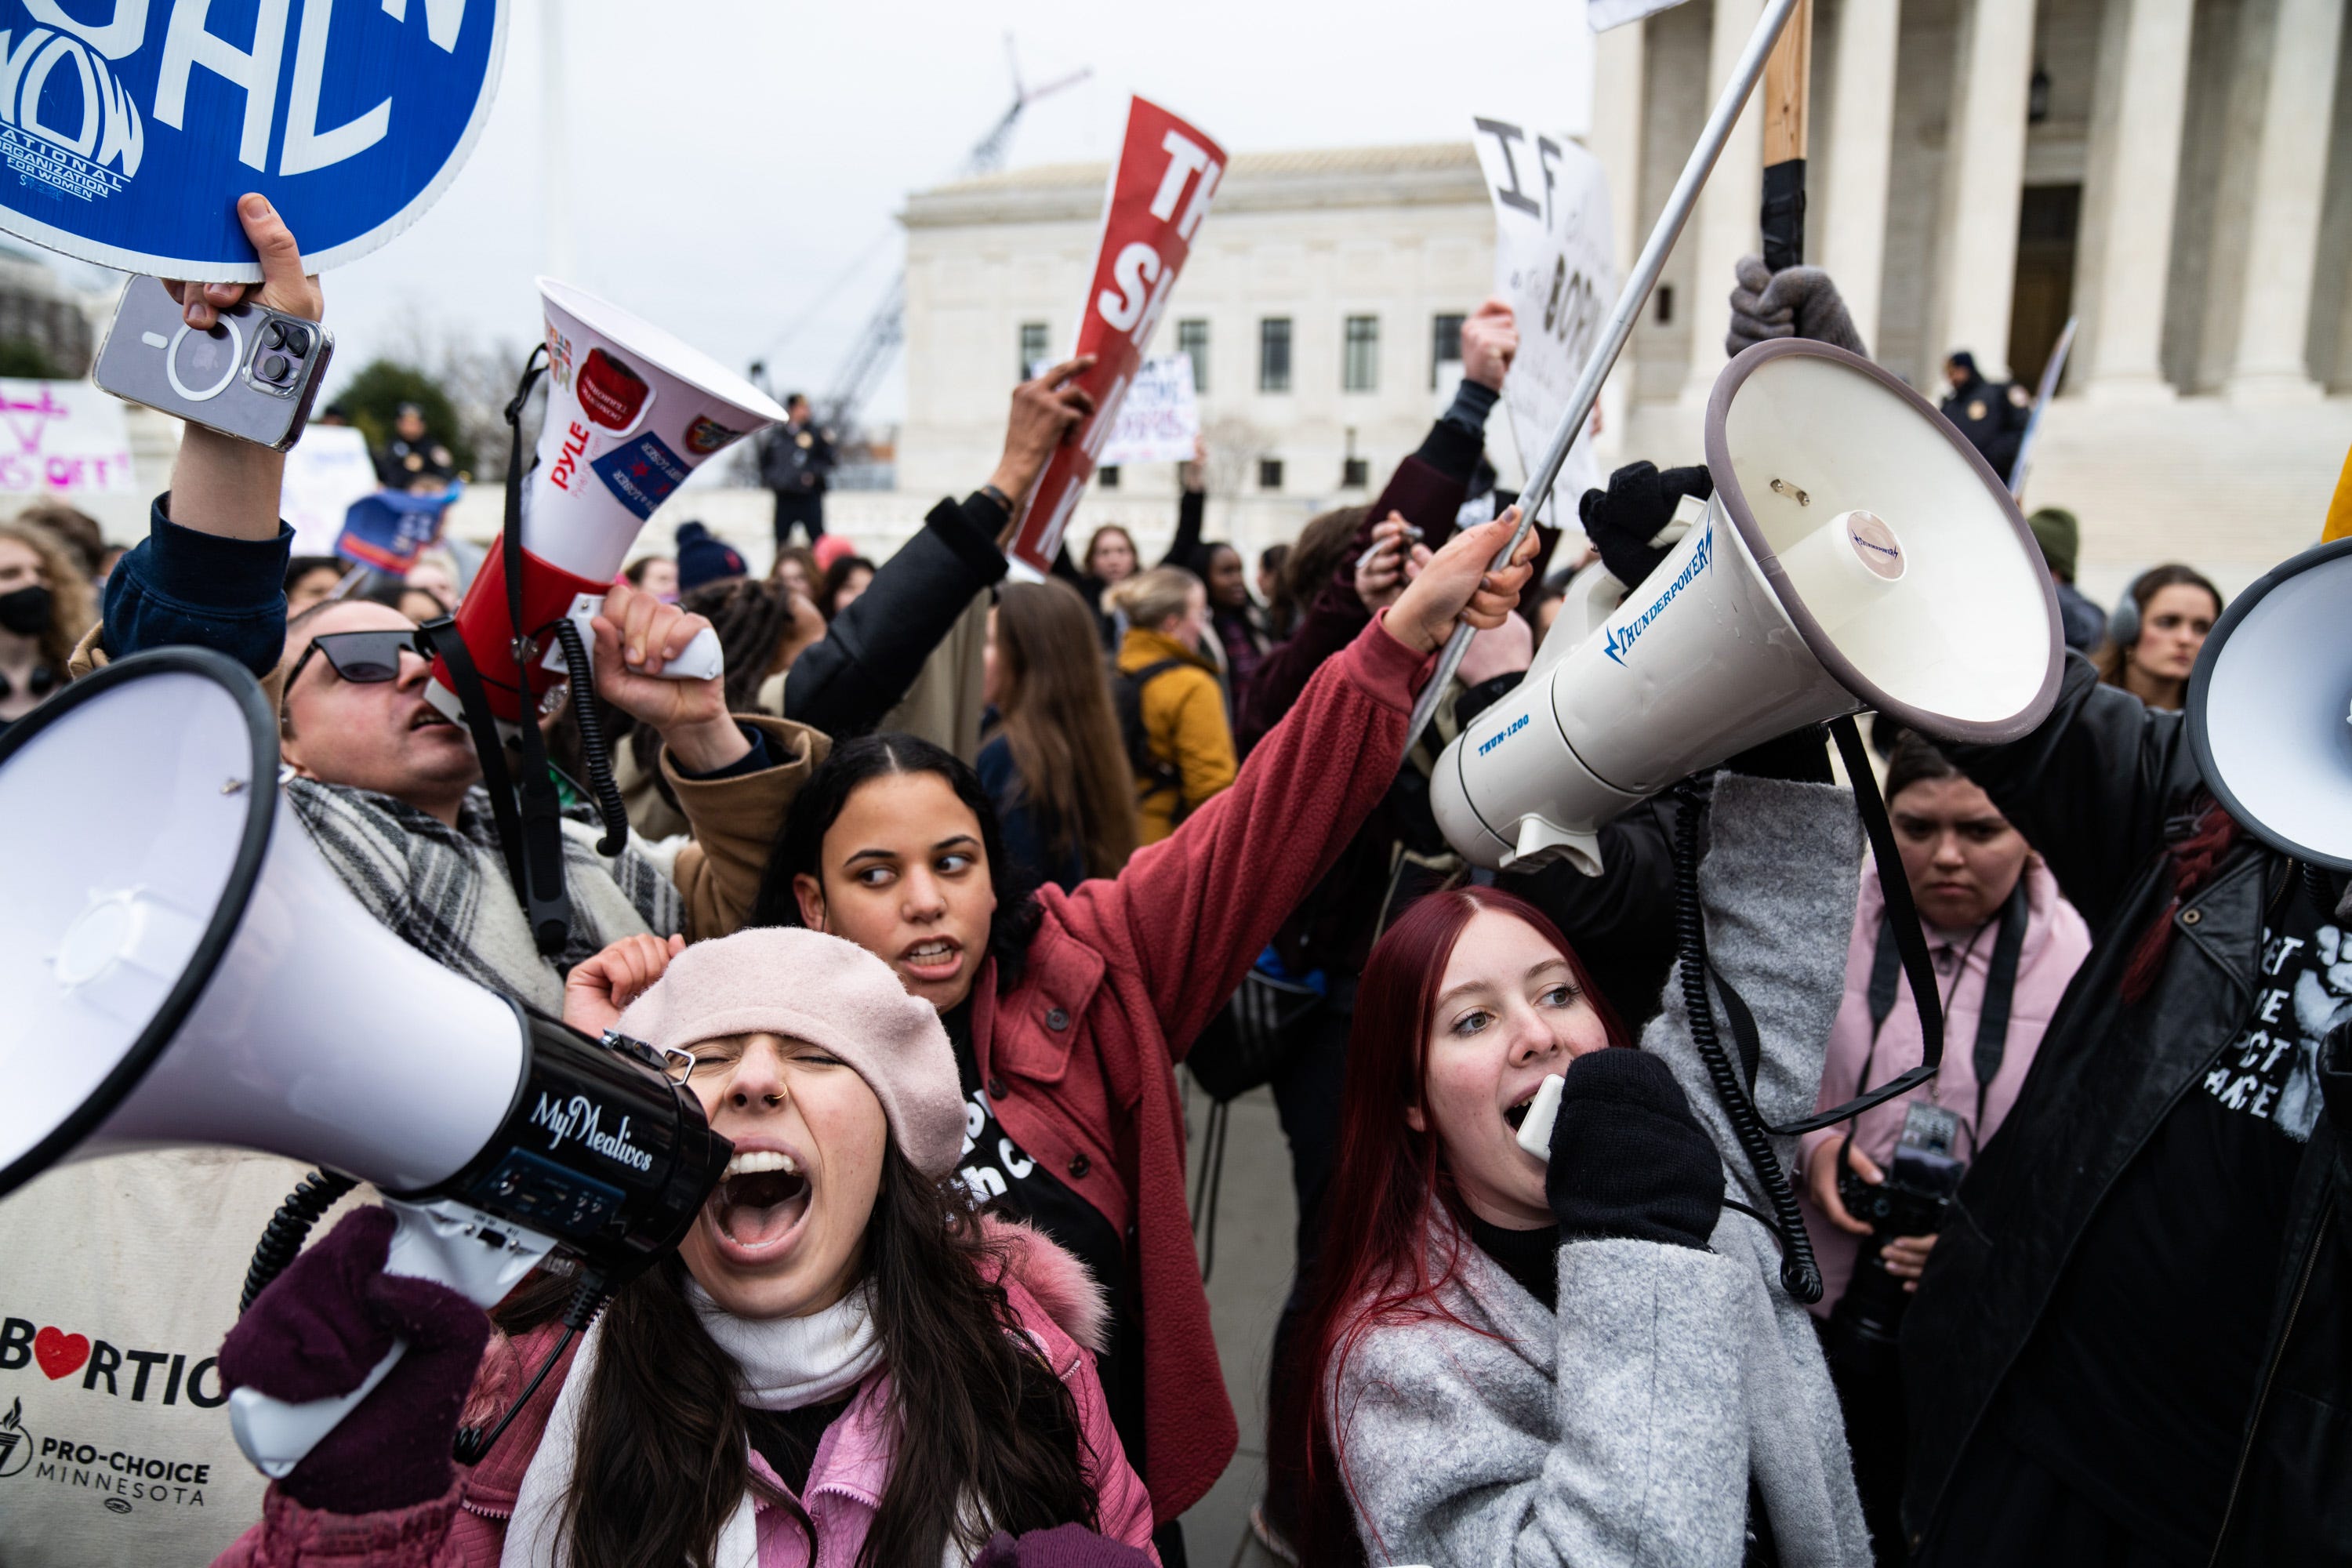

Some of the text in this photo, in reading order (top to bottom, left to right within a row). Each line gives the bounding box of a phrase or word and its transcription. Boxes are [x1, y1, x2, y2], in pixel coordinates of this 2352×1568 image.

[7, 156, 34, 174] FOR
[38, 169, 93, 199] WOMEN
[1474, 116, 1563, 234] IF
[550, 421, 590, 492] PYLE
[1617, 535, 1710, 655] THUNDERPOWER
[1478, 713, 1530, 757] THUN-1200
[529, 1091, 653, 1173] MyMealivos
[35, 1461, 205, 1507] MINNESOTA
[41, 1436, 211, 1485] PRO-CHOICE
